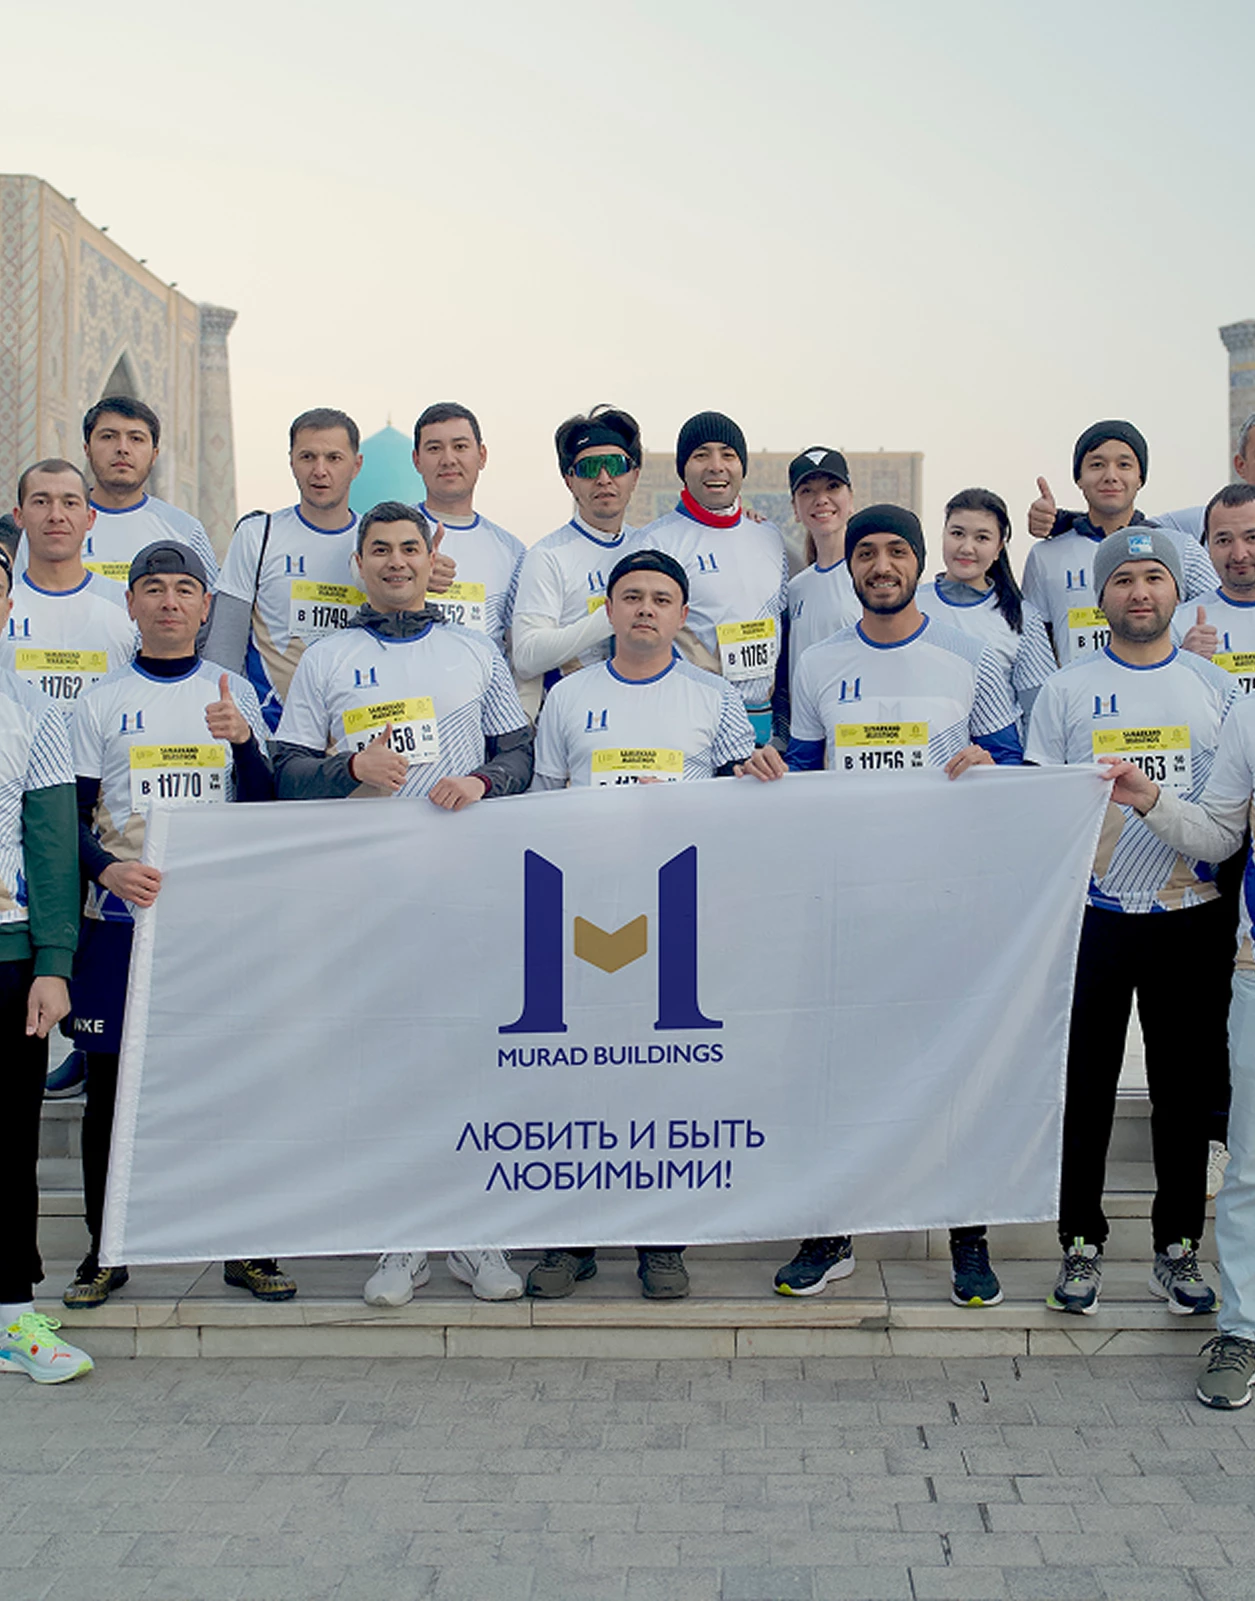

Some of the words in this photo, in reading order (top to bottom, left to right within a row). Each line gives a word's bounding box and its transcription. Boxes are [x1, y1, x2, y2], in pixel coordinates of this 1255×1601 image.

[312, 606, 348, 629] 11749
[1092, 630, 1112, 650] 117
[740, 643, 768, 668] 11765
[40, 676, 82, 699] 11762
[845, 756, 853, 770] B
[859, 750, 904, 769] 11756
[142, 780, 151, 795] B
[157, 772, 201, 798] 11770
[498, 1047, 588, 1067] MURAD
[593, 1043, 724, 1065] BUILDINGS
[456, 1120, 618, 1151] ЛЮБИТЬ
[630, 1120, 655, 1150] И
[668, 1118, 765, 1149] БЫТЬ
[485, 1159, 732, 1191] ЛЮБИМЫМИ!
